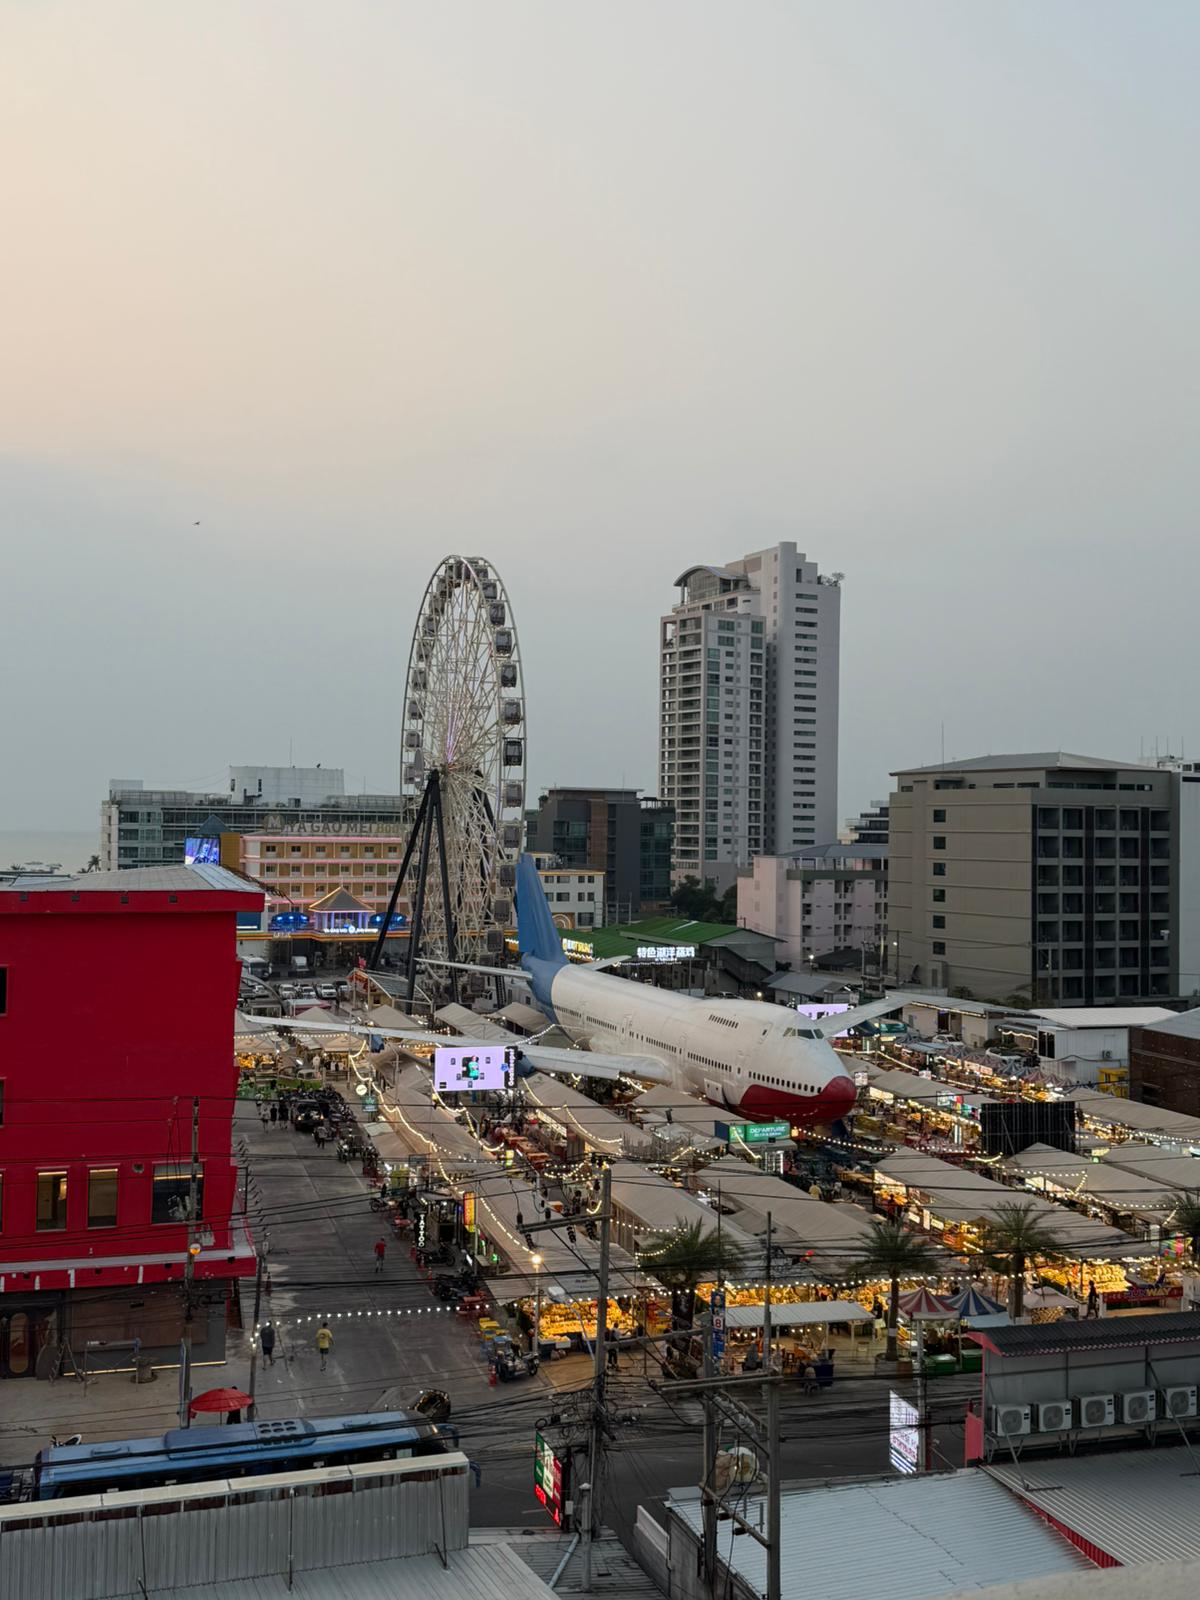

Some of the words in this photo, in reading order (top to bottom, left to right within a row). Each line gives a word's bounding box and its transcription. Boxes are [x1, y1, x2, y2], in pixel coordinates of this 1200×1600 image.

[288, 820, 307, 833] YA
[310, 821, 342, 833] GAO
[346, 821, 373, 834] MEI
[418, 1213, 426, 1248] TATTOO
[715, 1318, 721, 1328] 8
